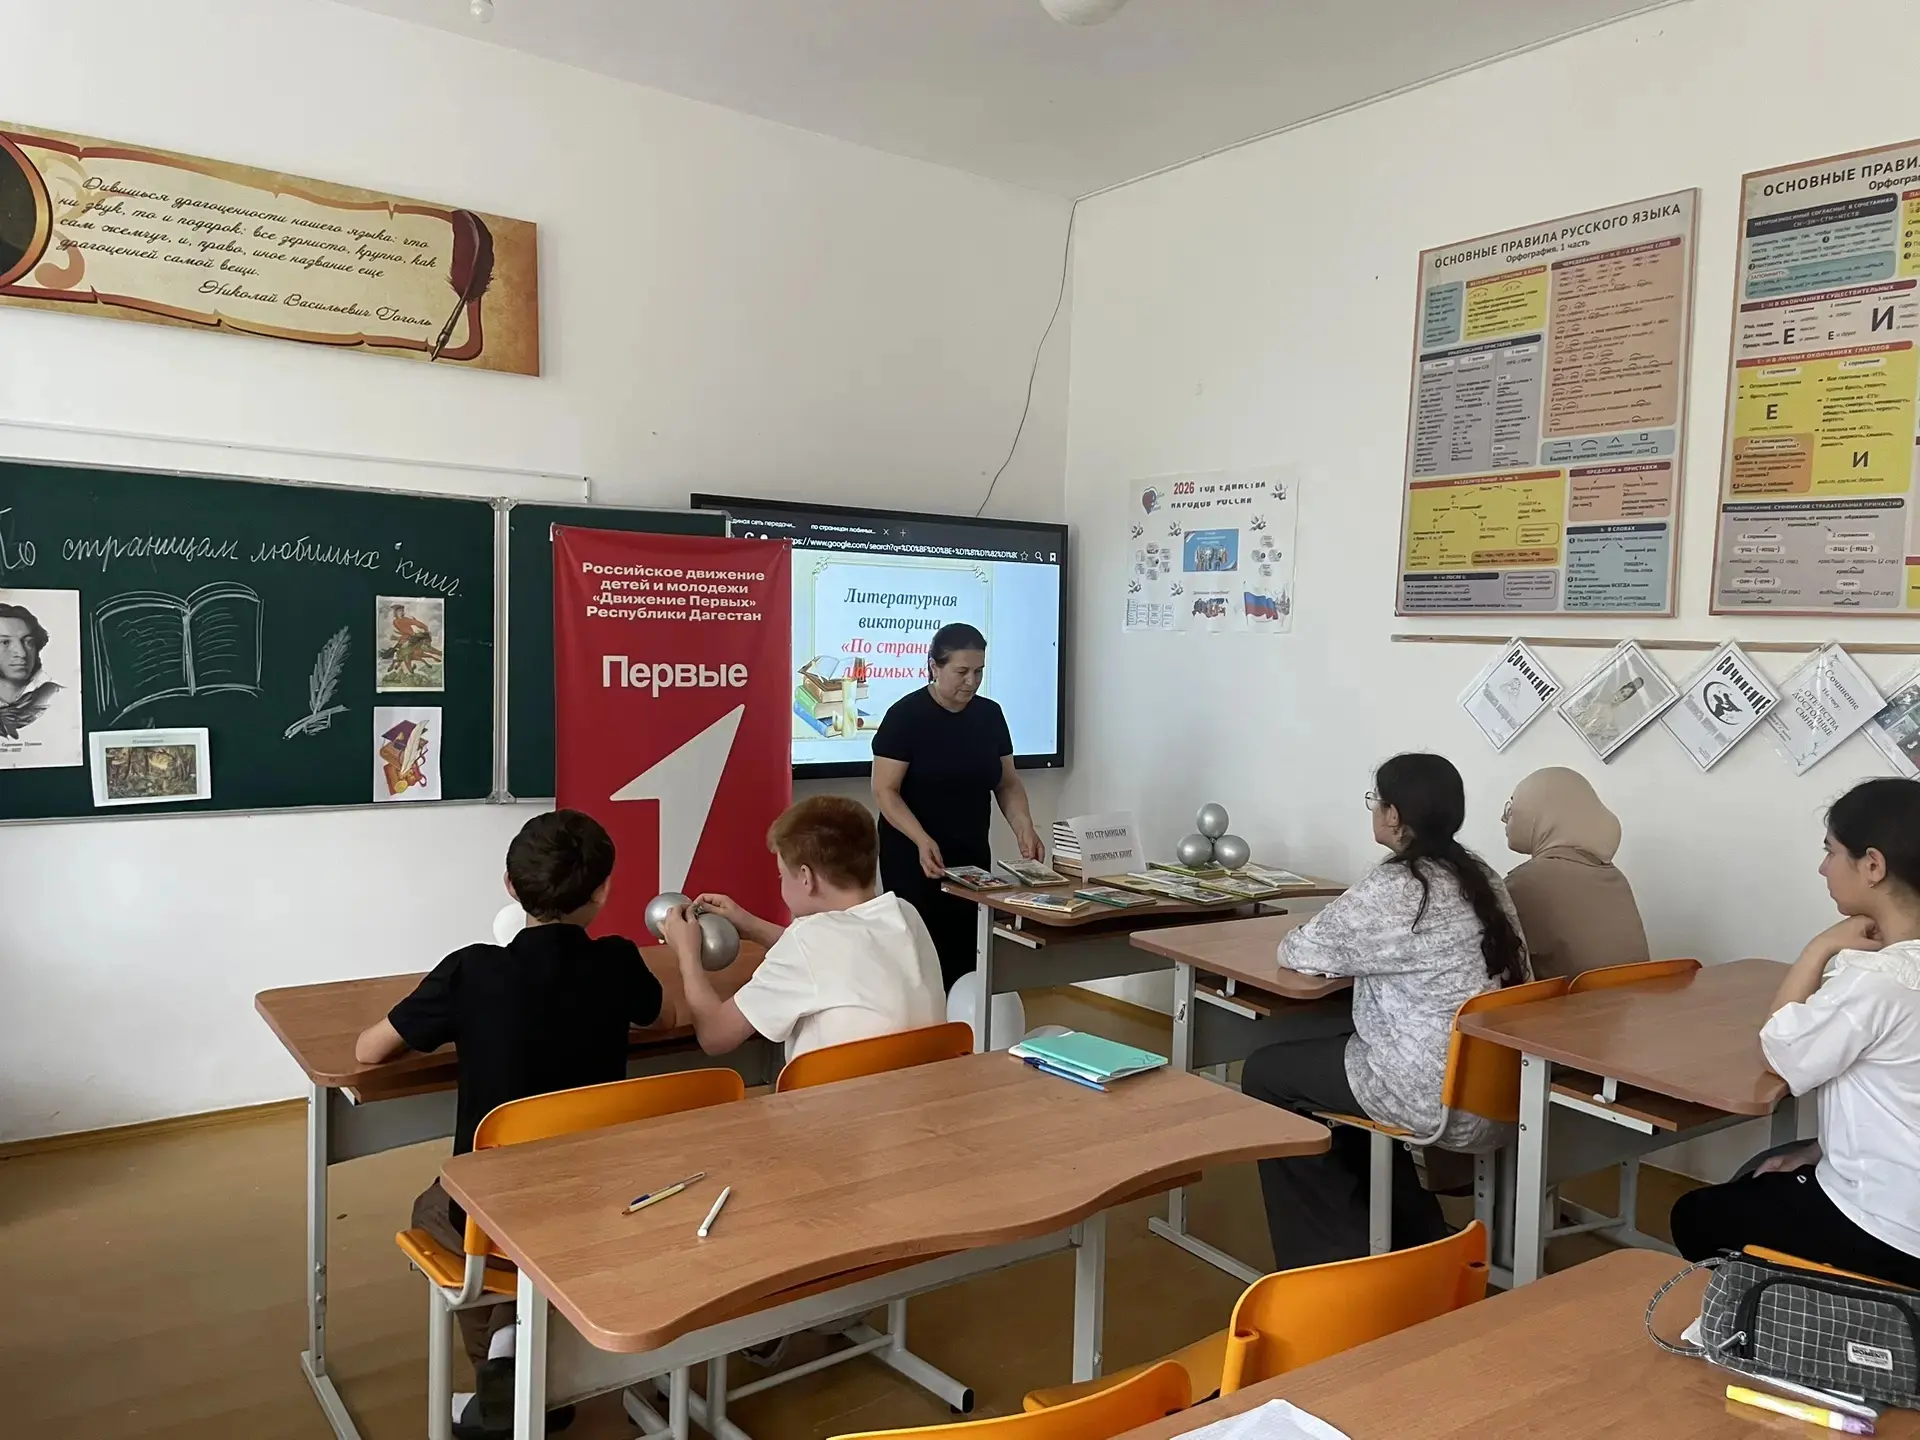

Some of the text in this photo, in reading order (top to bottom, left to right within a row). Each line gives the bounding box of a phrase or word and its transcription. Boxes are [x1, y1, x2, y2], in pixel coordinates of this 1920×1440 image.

[1763, 155, 1920, 197] ОСНОВНЫЕ ПРАВИ
[82, 177, 430, 248] Дивишься драгоценности нашего языка: что
[58, 197, 437, 268] ни звук, то и подарок: все зернисто, крупно, как
[1435, 203, 1681, 269] ОСНОВНЫЕ ПРАВИЛА РУССКОГО ЯЗЫКА
[59, 218, 385, 279] сам жемчуг, и, право, иное название еще
[1567, 239, 1590, 249] часть
[56, 238, 260, 277] драгоценней самой вещи.
[1826, 284, 1895, 300] СУЩЕСТВИТЕЛЬНЫХ
[198, 280, 433, 327] Николай Васильевич Гоголь
[1871, 305, 1895, 332] И
[1783, 327, 1796, 345] Е
[1827, 331, 1835, 340] Е
[1766, 403, 1779, 420] Е
[1852, 451, 1869, 468] И
[1173, 481, 1195, 495] 2026
[62, 535, 240, 573] страницам
[250, 535, 380, 570] любимых
[582, 561, 765, 581] Российское движение
[600, 579, 749, 594] детей и молодежи
[592, 592, 756, 609] «Движение Первых»
[844, 588, 958, 610] Литературная
[586, 605, 762, 622] Республики Дагестан
[858, 616, 941, 633] викторина
[841, 638, 872, 654] «По
[602, 655, 749, 698] Первые
[1507, 649, 1555, 702] СОЧИНЕНИЕ
[1716, 656, 1772, 716] СОЧИНЕНИЕ
[1825, 669, 1860, 711] Сочинение
